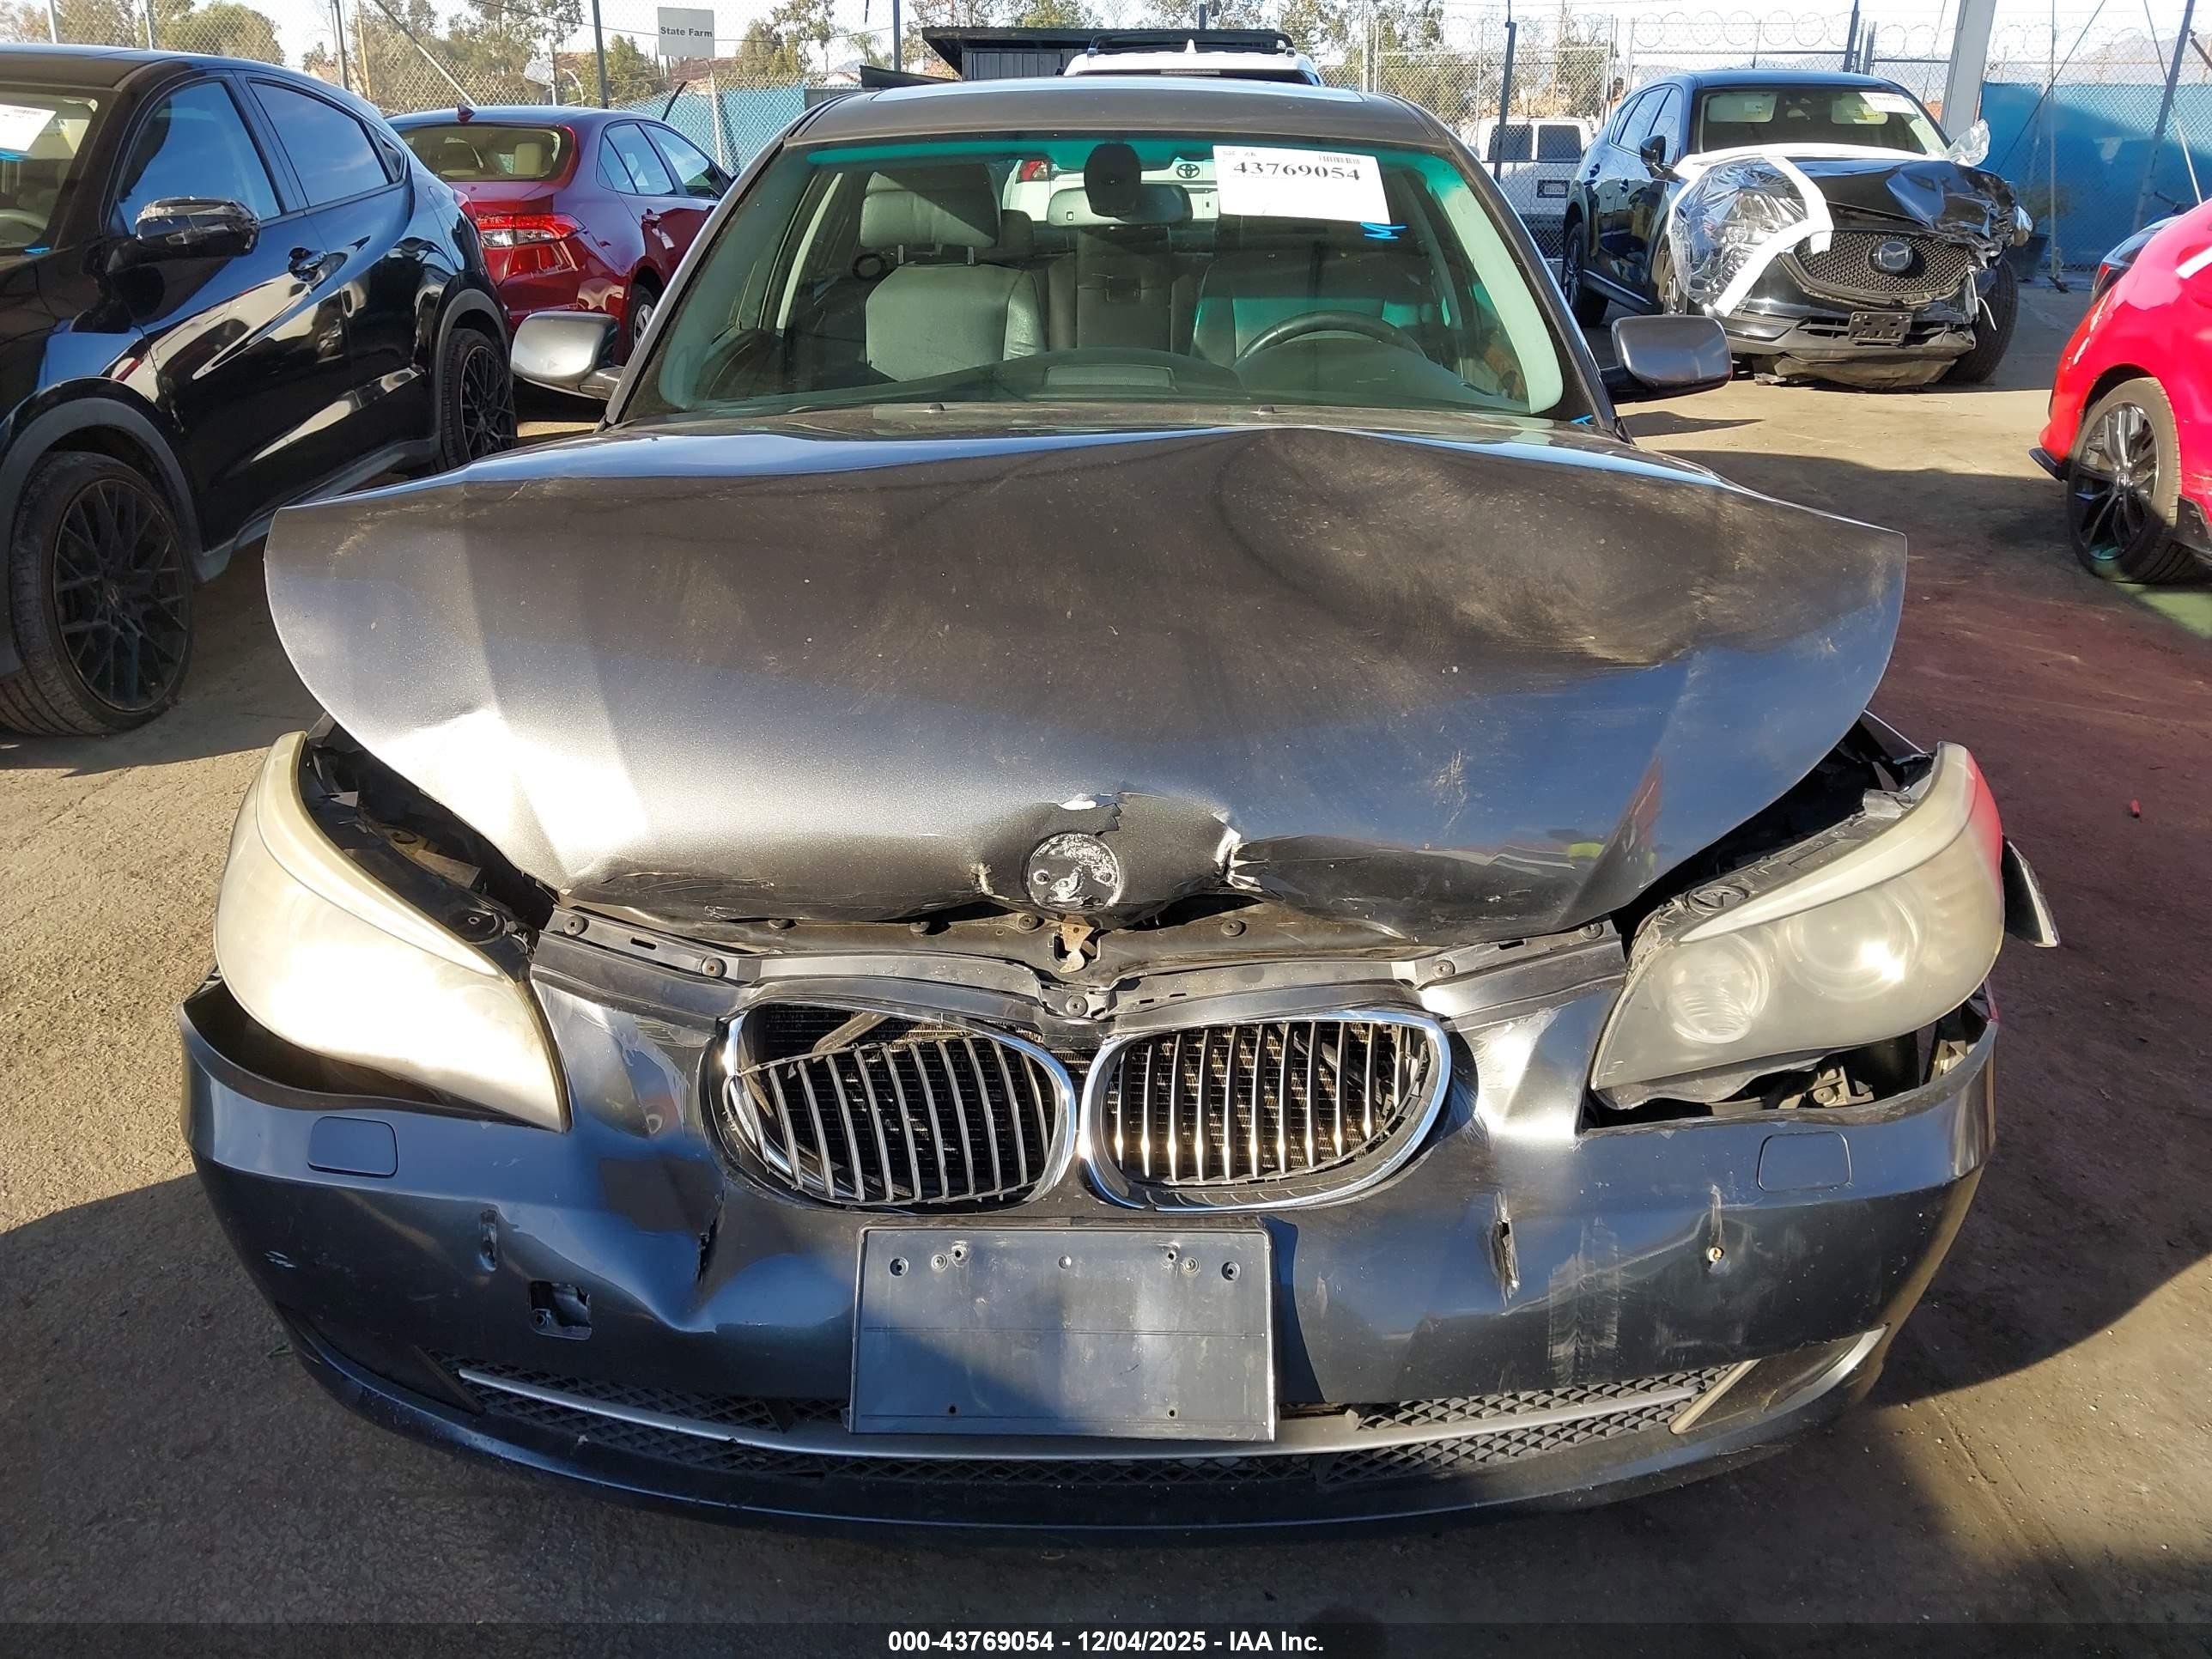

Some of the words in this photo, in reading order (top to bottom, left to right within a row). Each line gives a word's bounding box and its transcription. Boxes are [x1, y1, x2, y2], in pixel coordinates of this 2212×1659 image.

[660, 27, 685, 36] State
[689, 28, 713, 37] Farm
[1233, 161, 1360, 180] 43769054
